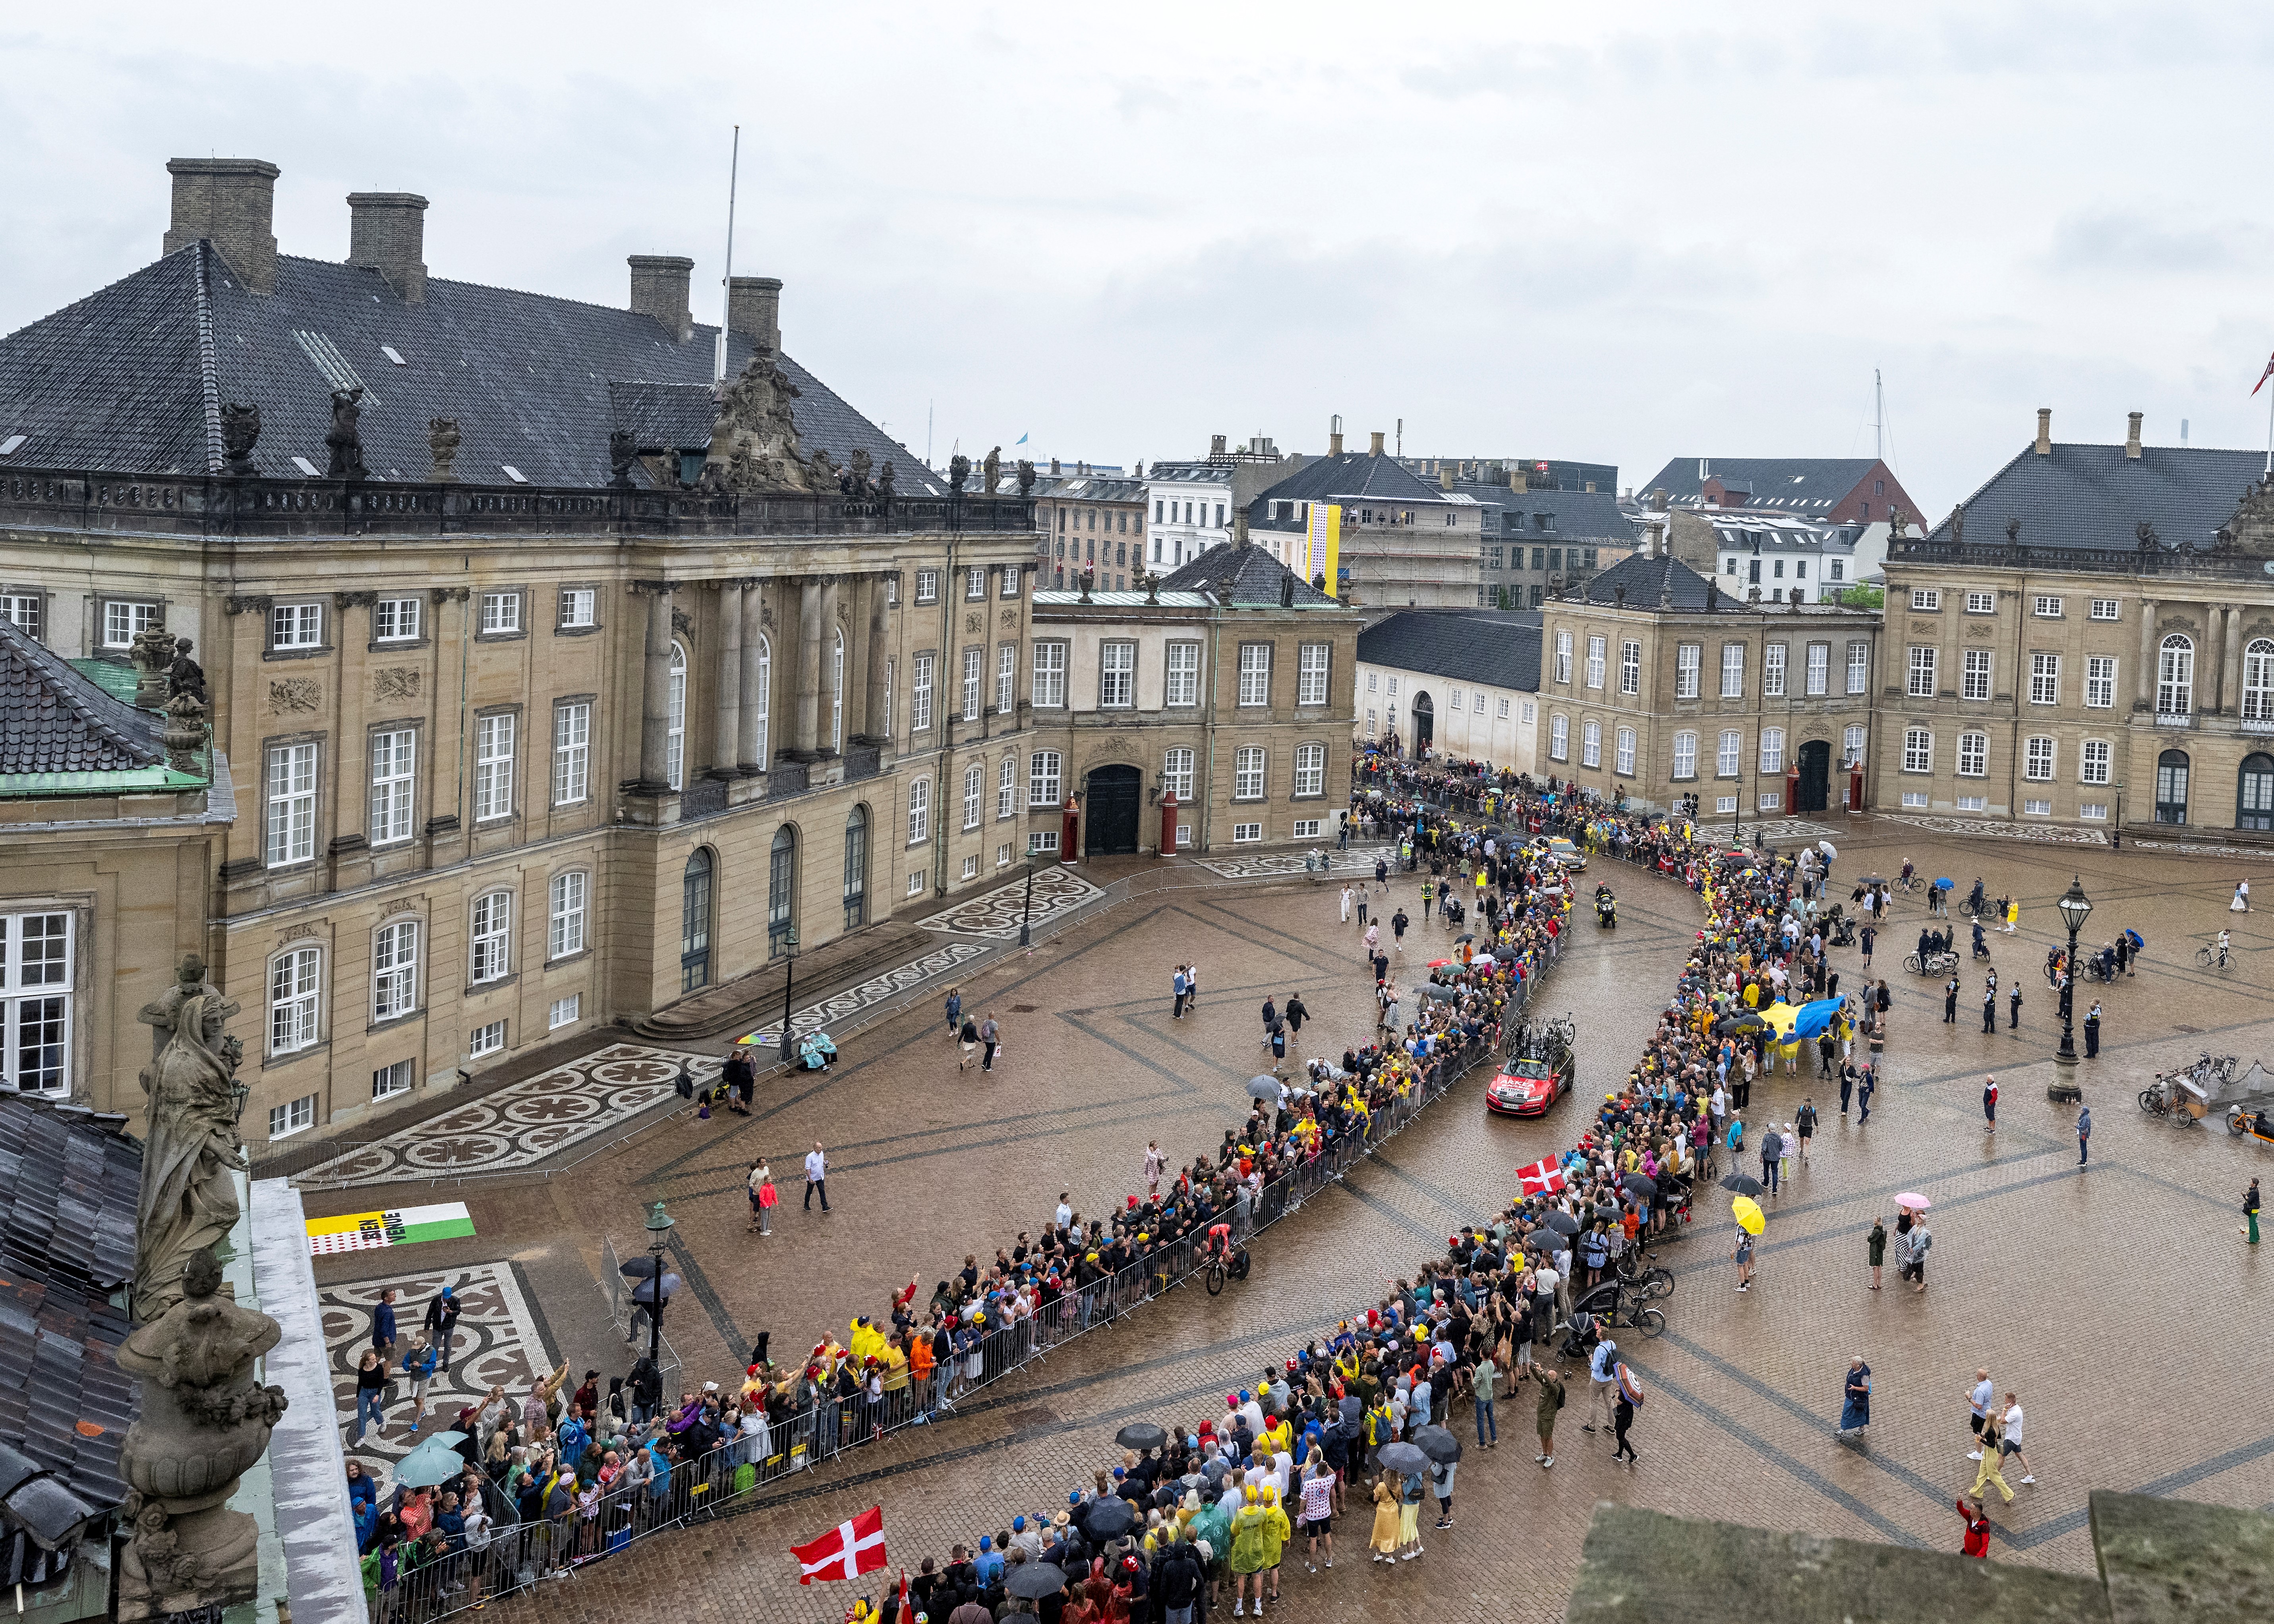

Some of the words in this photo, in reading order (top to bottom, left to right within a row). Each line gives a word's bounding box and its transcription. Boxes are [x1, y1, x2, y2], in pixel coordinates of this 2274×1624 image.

[358, 1219, 380, 1240] BIEN
[381, 1212, 407, 1243] VENUE
[1477, 1297, 1486, 1310] 11
